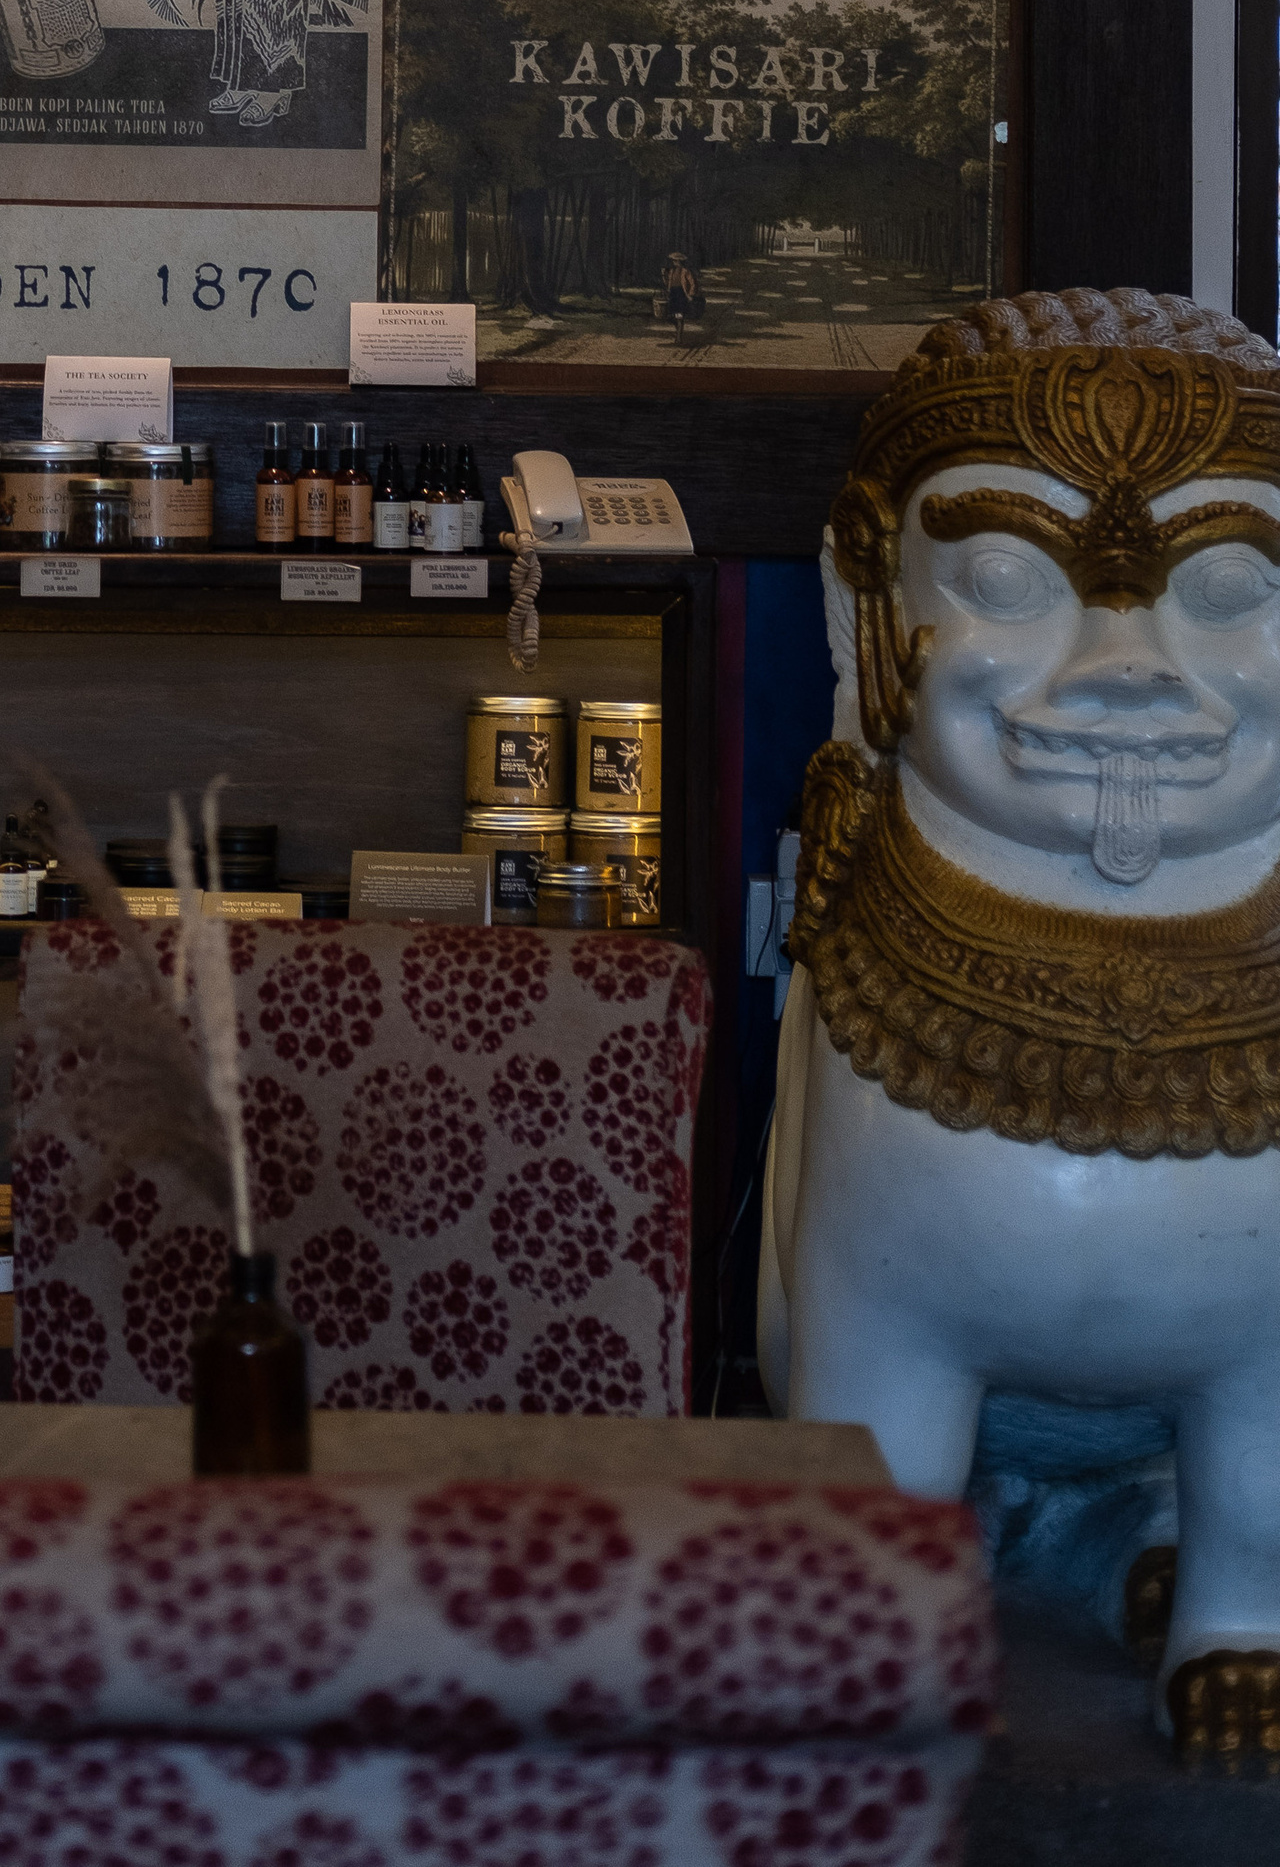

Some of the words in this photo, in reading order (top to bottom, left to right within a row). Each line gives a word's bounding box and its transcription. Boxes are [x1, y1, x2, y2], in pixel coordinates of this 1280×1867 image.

[509, 39, 881, 91] KAWISARI
[39, 97, 70, 113] KOPI
[76, 99, 125, 114] PALING
[130, 99, 166, 114] TOEA
[56, 118, 108, 133] SEDJAK
[115, 119, 167, 134] TAHOEN
[173, 120, 205, 134] 1870
[557, 95, 831, 147] KOFFIE
[381, 308, 445, 316] LEMONGRASS
[378, 318, 429, 326] ESSENTIAL
[431, 318, 449, 326] OIL
[65, 371, 85, 379] THE
[88, 372, 106, 380] TEA
[108, 372, 149, 381] SOCIETY
